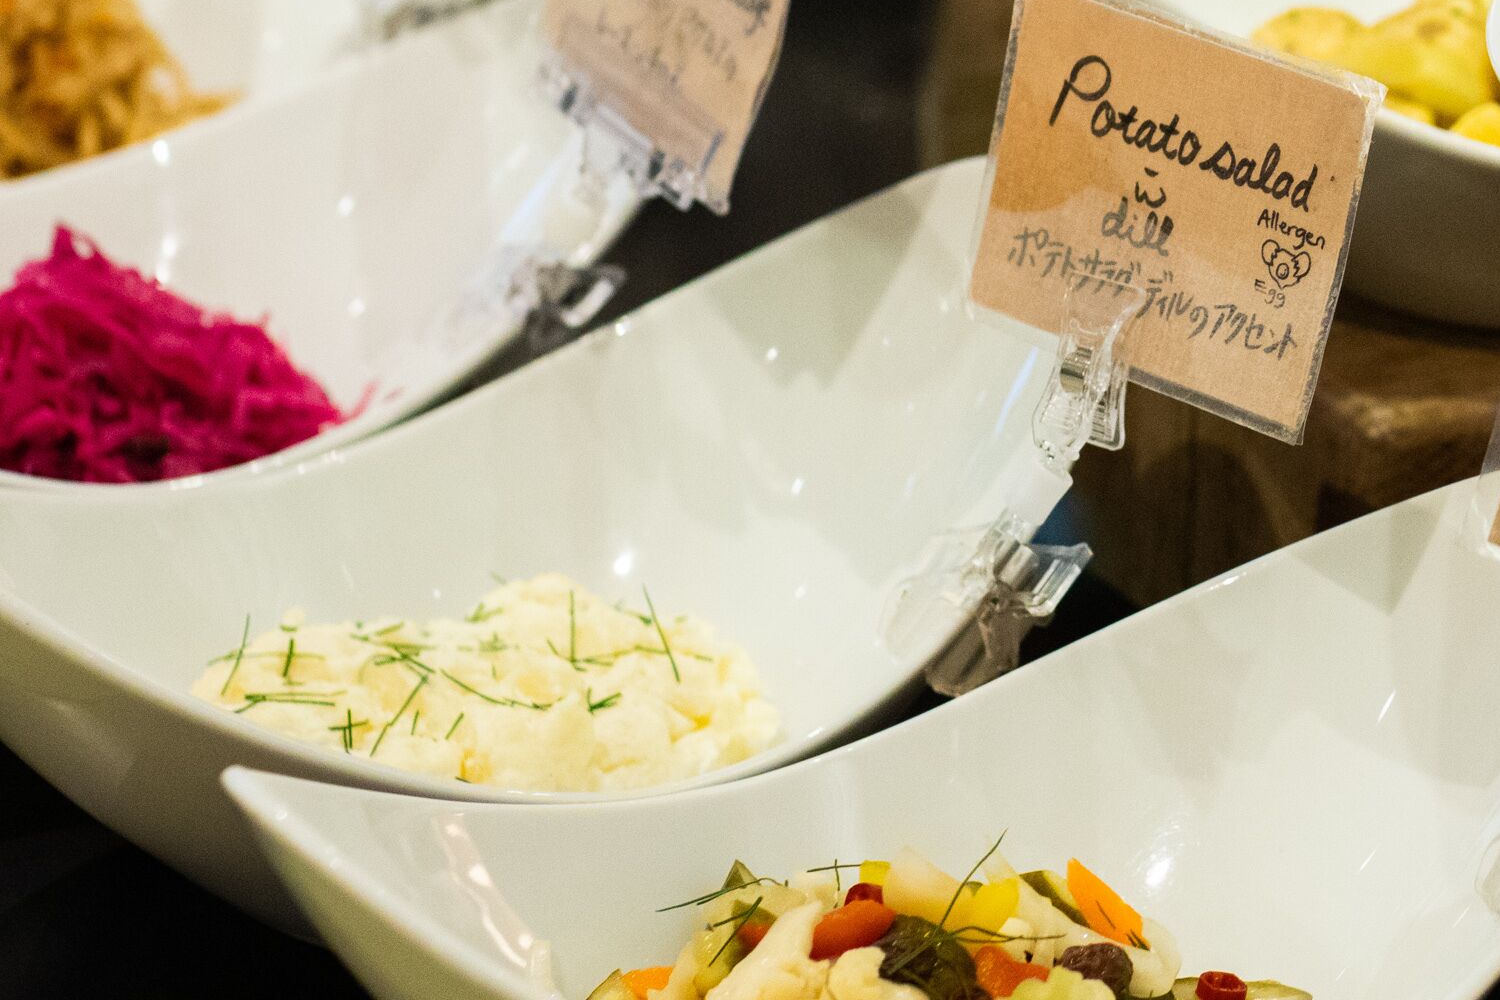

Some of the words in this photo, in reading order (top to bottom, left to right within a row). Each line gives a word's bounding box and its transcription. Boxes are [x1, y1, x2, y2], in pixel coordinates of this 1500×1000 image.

[1049, 55, 1202, 166] Potato
[1199, 142, 1318, 213] salad
[1102, 196, 1174, 257] dill
[1256, 208, 1326, 251] Allergen
[1254, 278, 1287, 309] Egg
